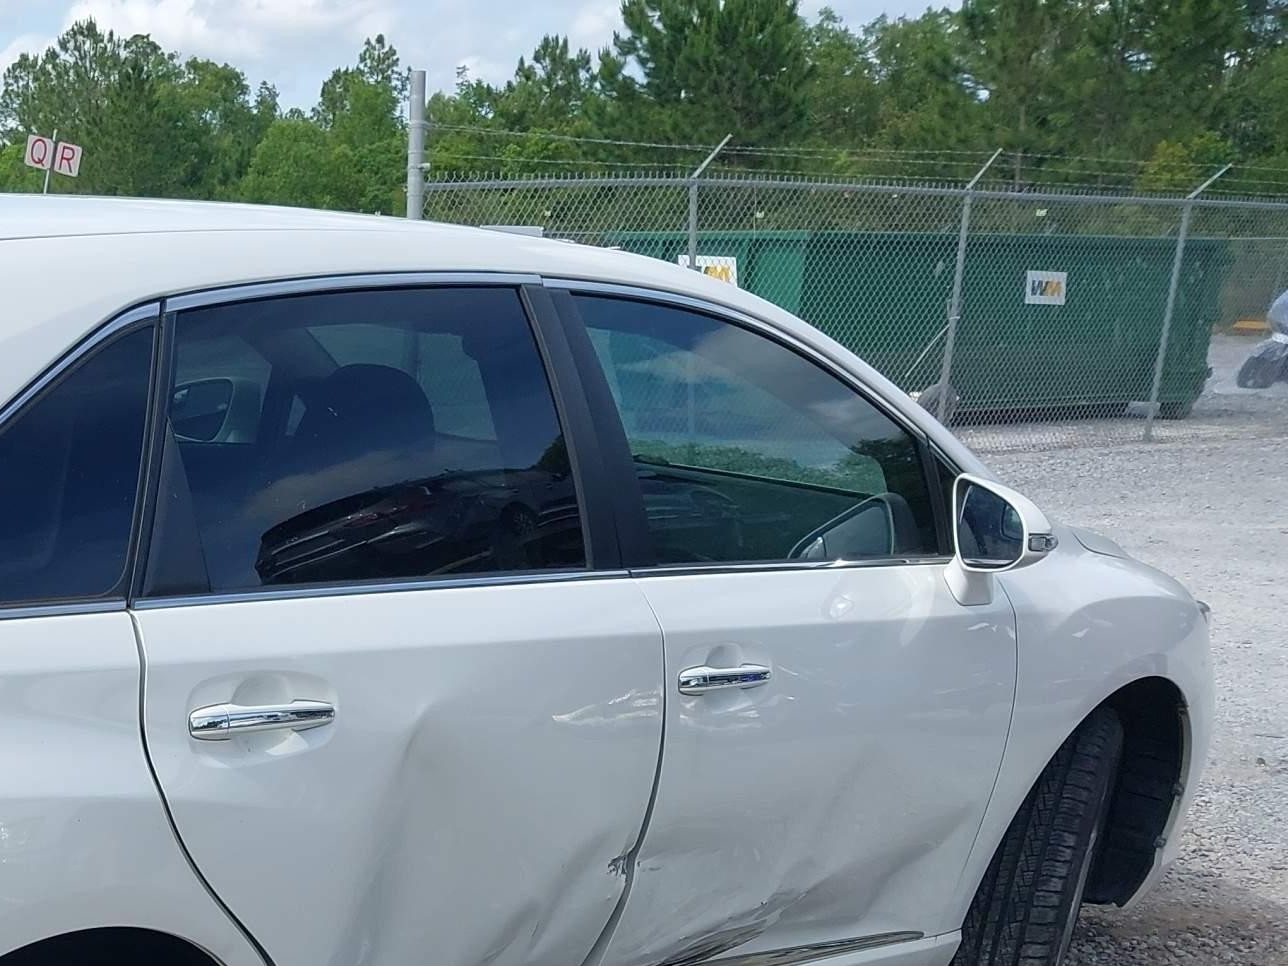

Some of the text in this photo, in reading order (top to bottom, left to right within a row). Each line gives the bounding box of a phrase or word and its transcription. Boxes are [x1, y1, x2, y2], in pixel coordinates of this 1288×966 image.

[30, 138, 75, 174] Q R
[1030, 279, 1062, 297] WM
